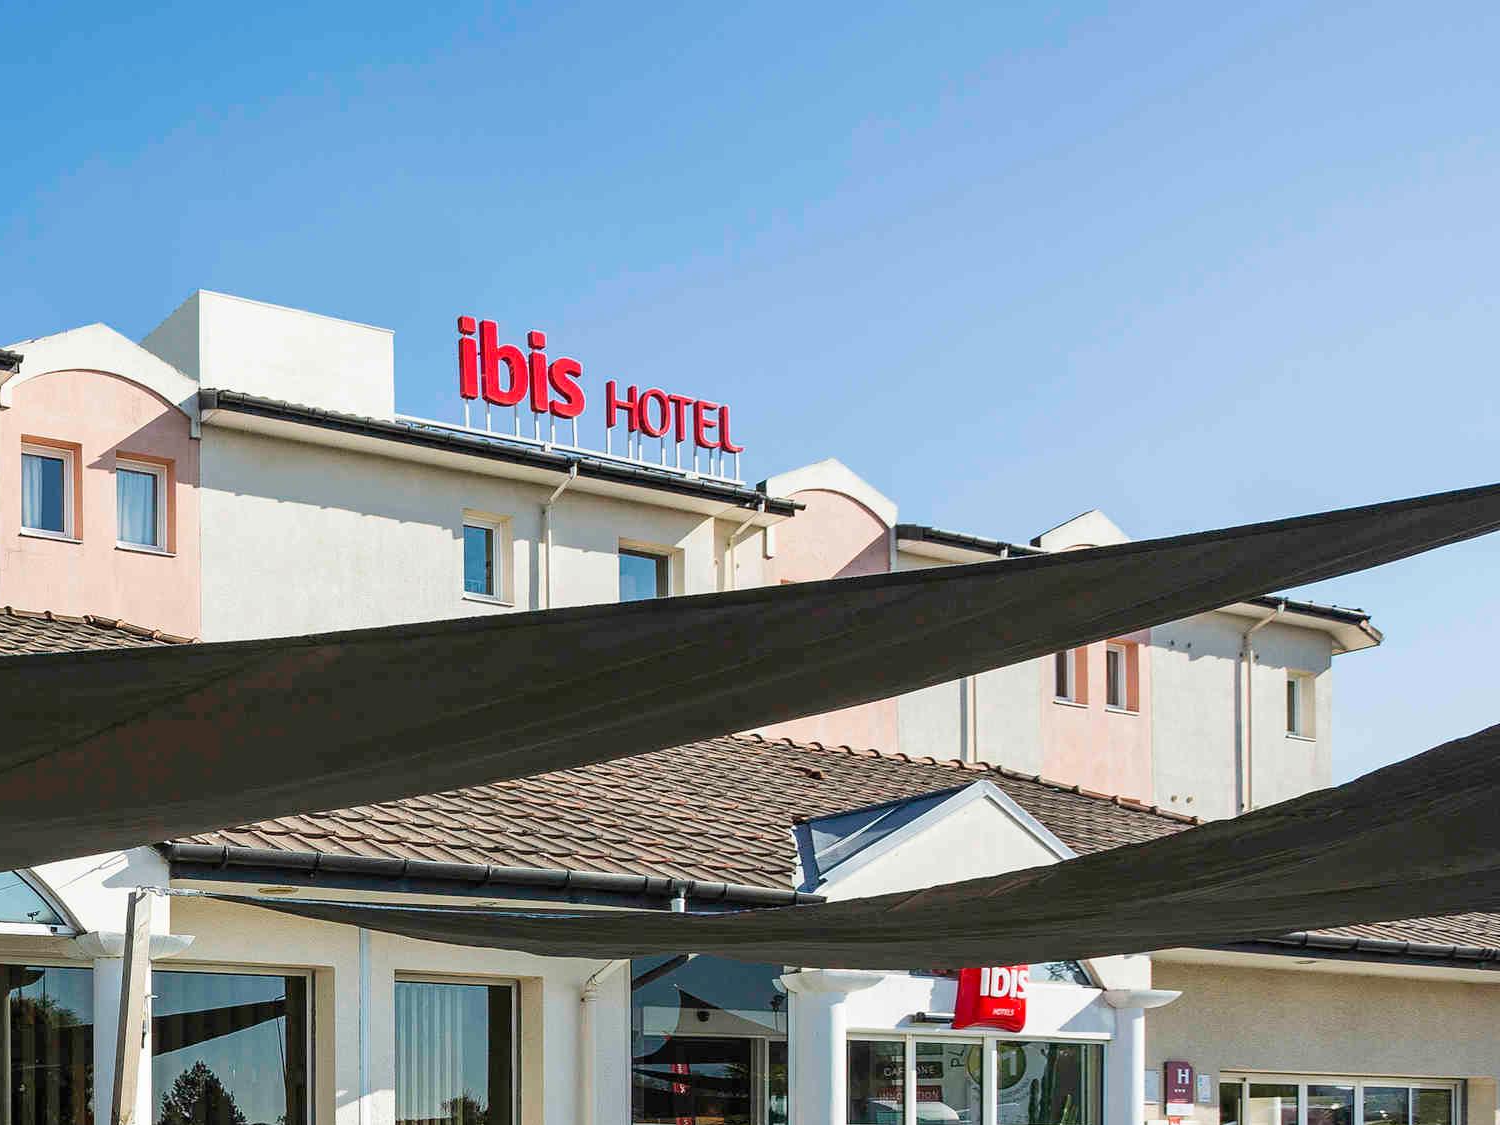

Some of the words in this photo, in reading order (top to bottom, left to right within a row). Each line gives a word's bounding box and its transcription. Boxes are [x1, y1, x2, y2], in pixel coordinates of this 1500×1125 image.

[458, 316, 586, 419] ibis
[605, 380, 744, 453] HOTEL
[1177, 1068, 1190, 1085] H
